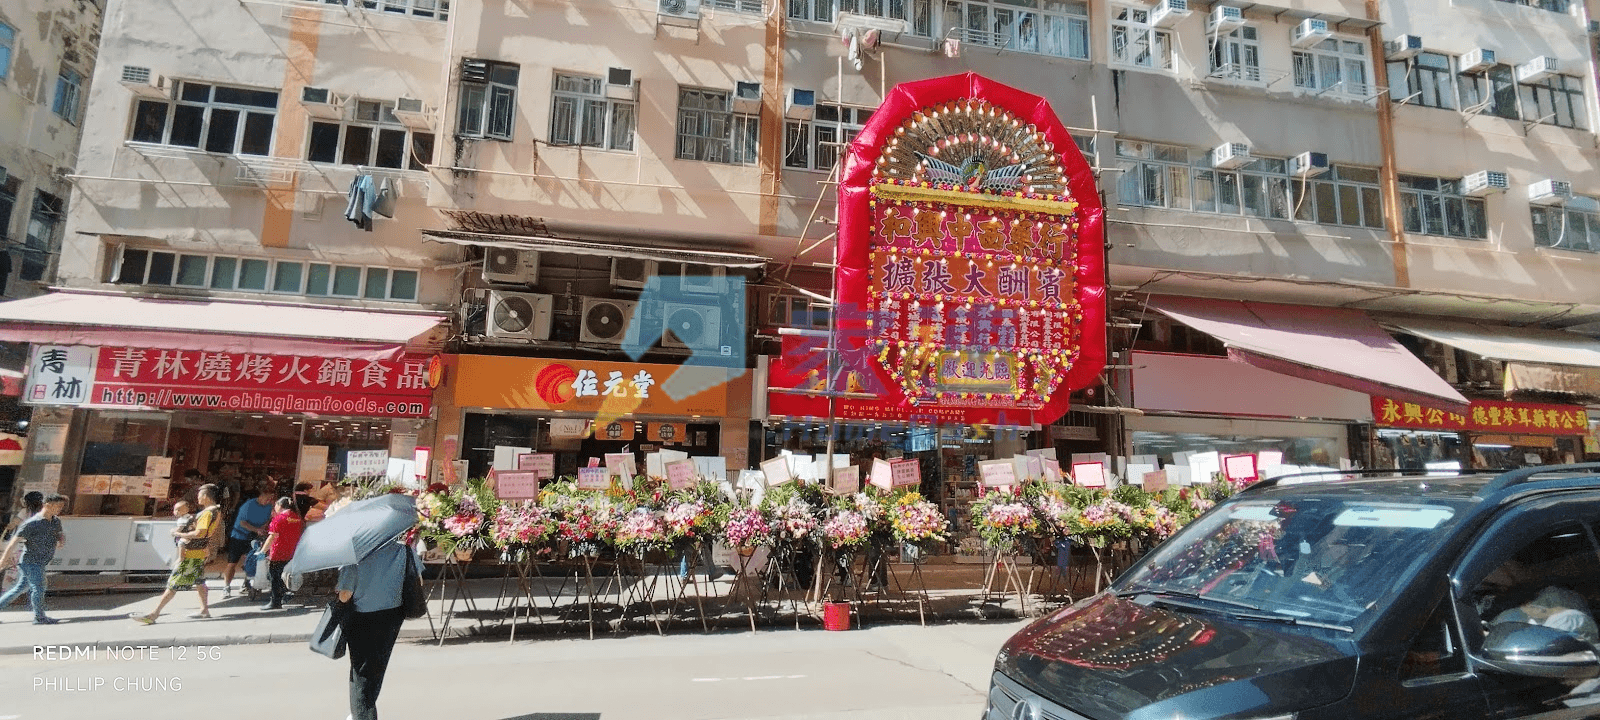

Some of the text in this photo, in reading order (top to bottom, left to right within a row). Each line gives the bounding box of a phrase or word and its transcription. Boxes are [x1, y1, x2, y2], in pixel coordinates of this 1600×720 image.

[881, 256, 1067, 304] 擴張大酬賓
[40, 349, 82, 399] 青林
[109, 347, 428, 389] 青林燒烤火鍋食品
[571, 368, 655, 399] 位元堂
[941, 359, 1011, 380] 歡迎光臨
[101, 387, 425, 415] http://www.chinglamfoods.com
